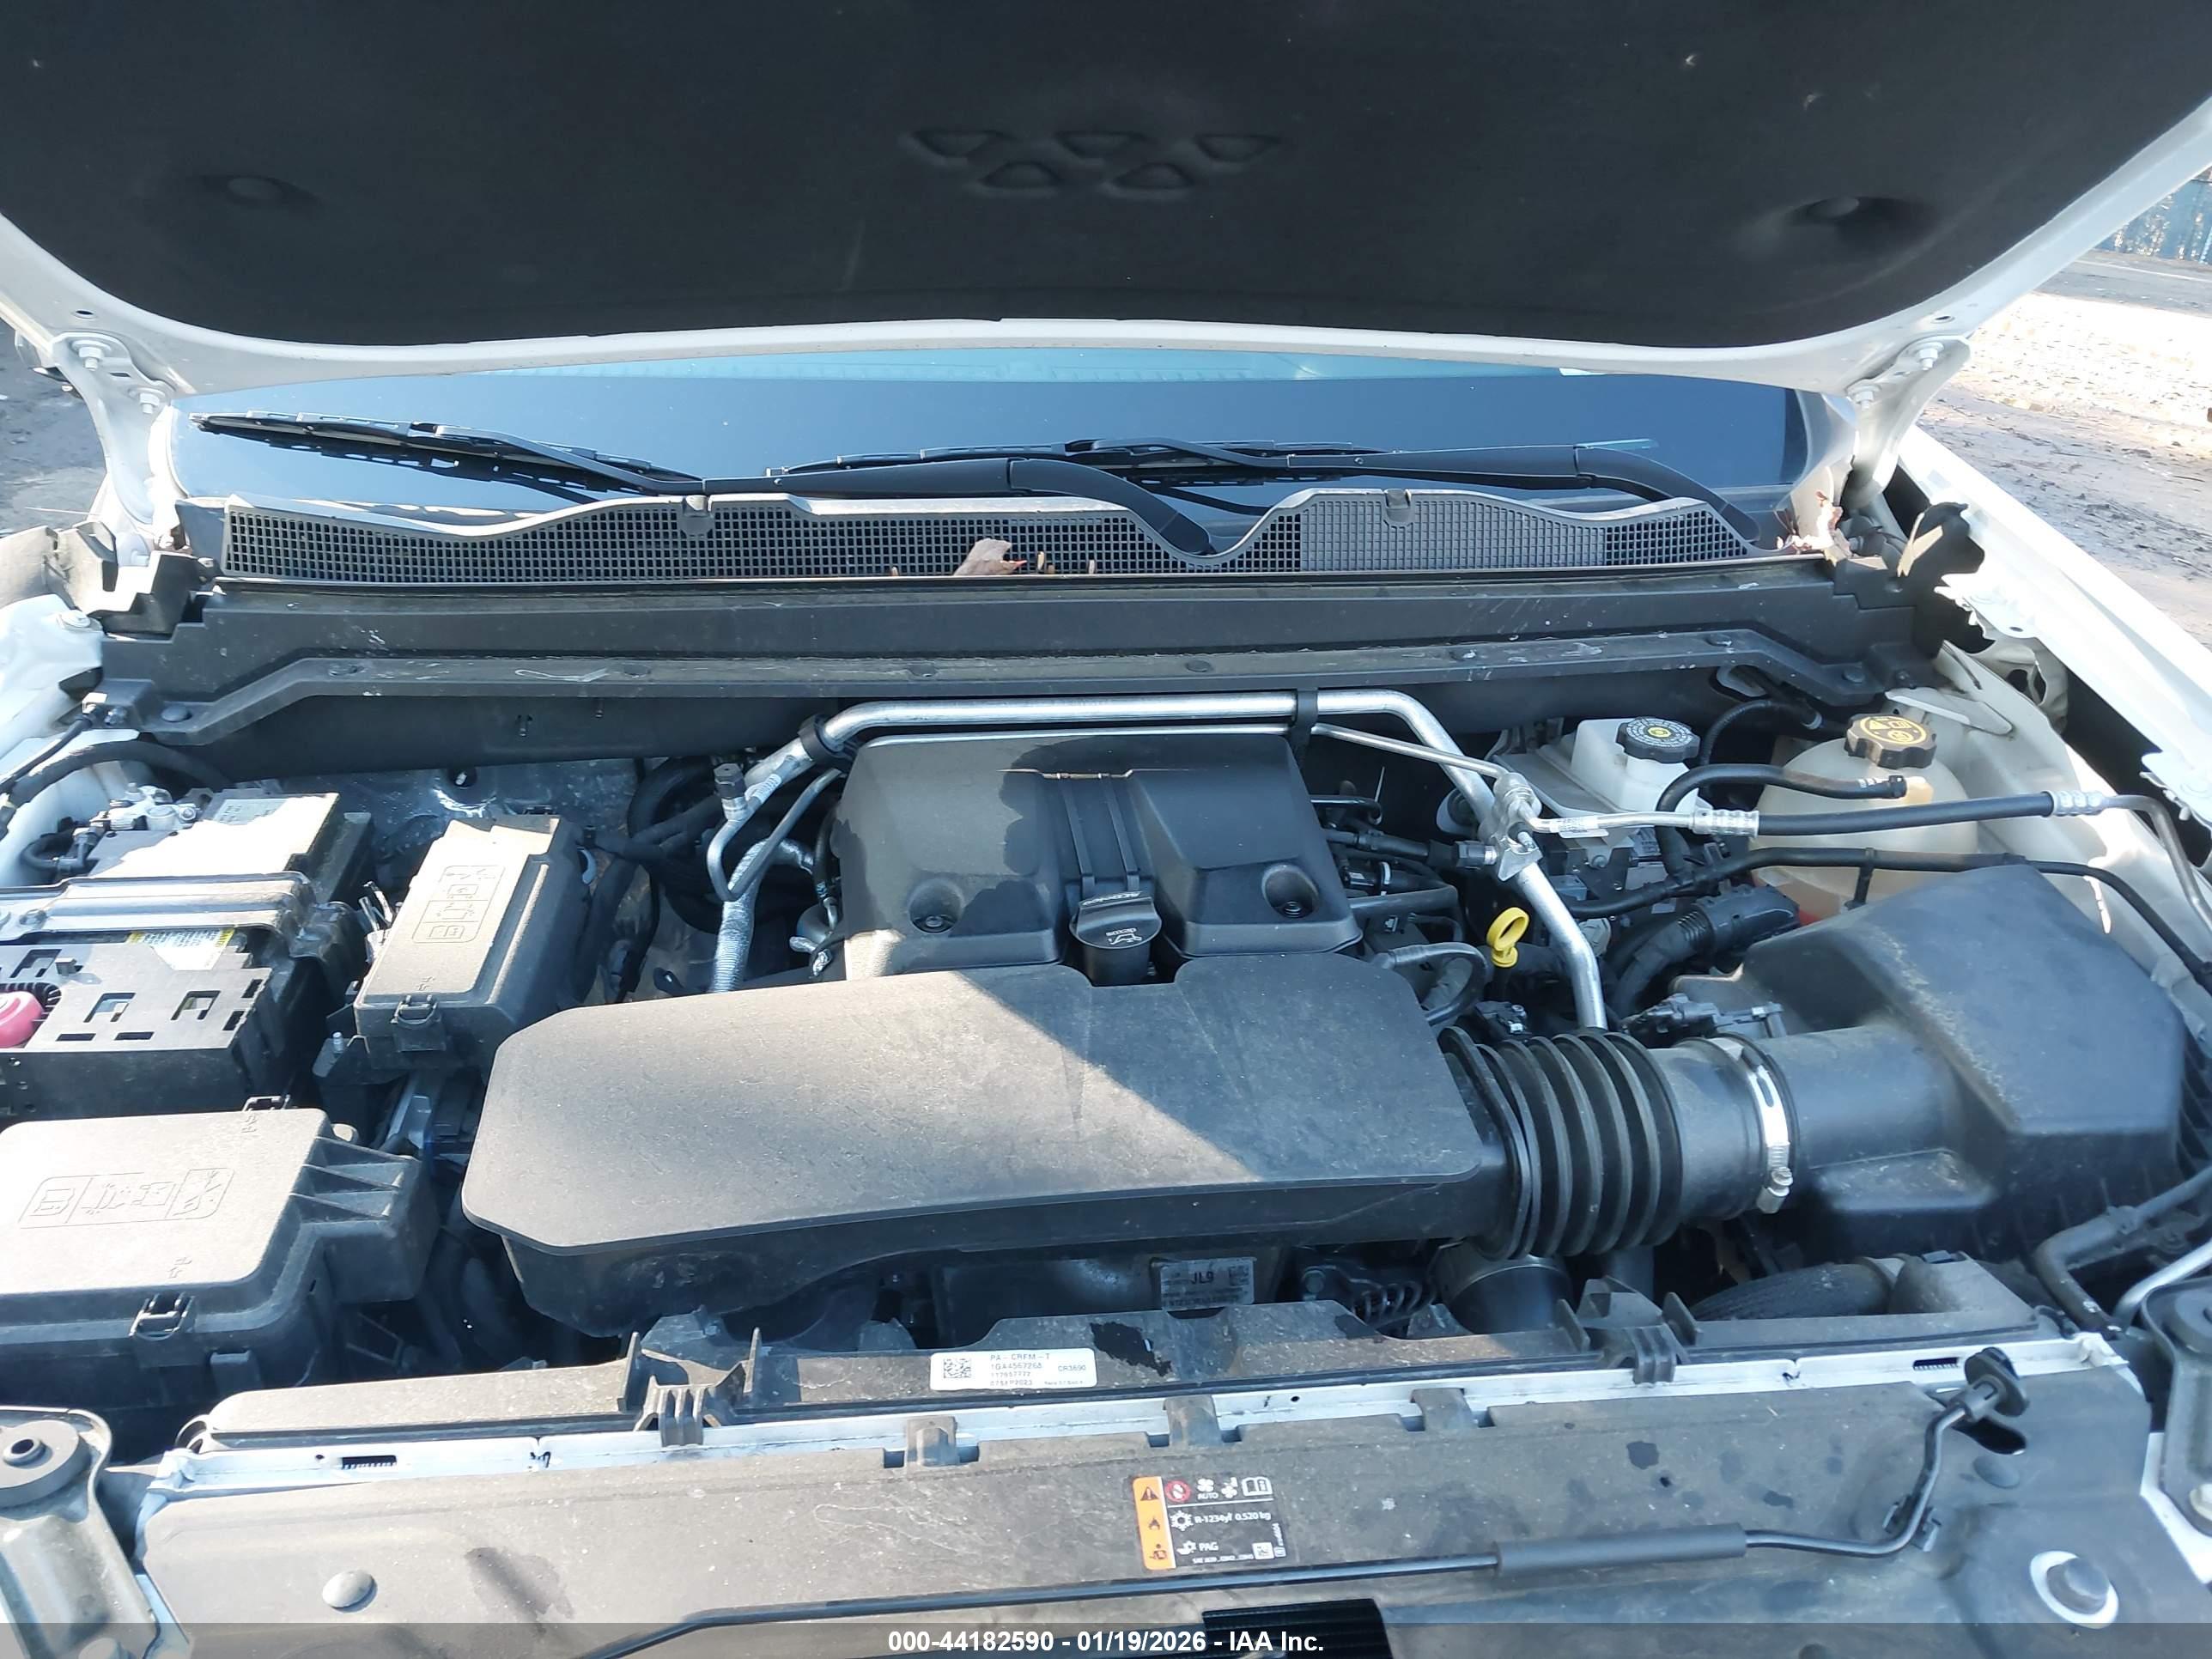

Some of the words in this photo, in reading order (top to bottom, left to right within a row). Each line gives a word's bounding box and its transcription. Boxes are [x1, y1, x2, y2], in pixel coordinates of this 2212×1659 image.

[1191, 1270, 1214, 1285] JL9
[1235, 1512, 1259, 1521] 0.520
[1259, 1510, 1272, 1521] kg
[1199, 1541, 1218, 1551] PAG
